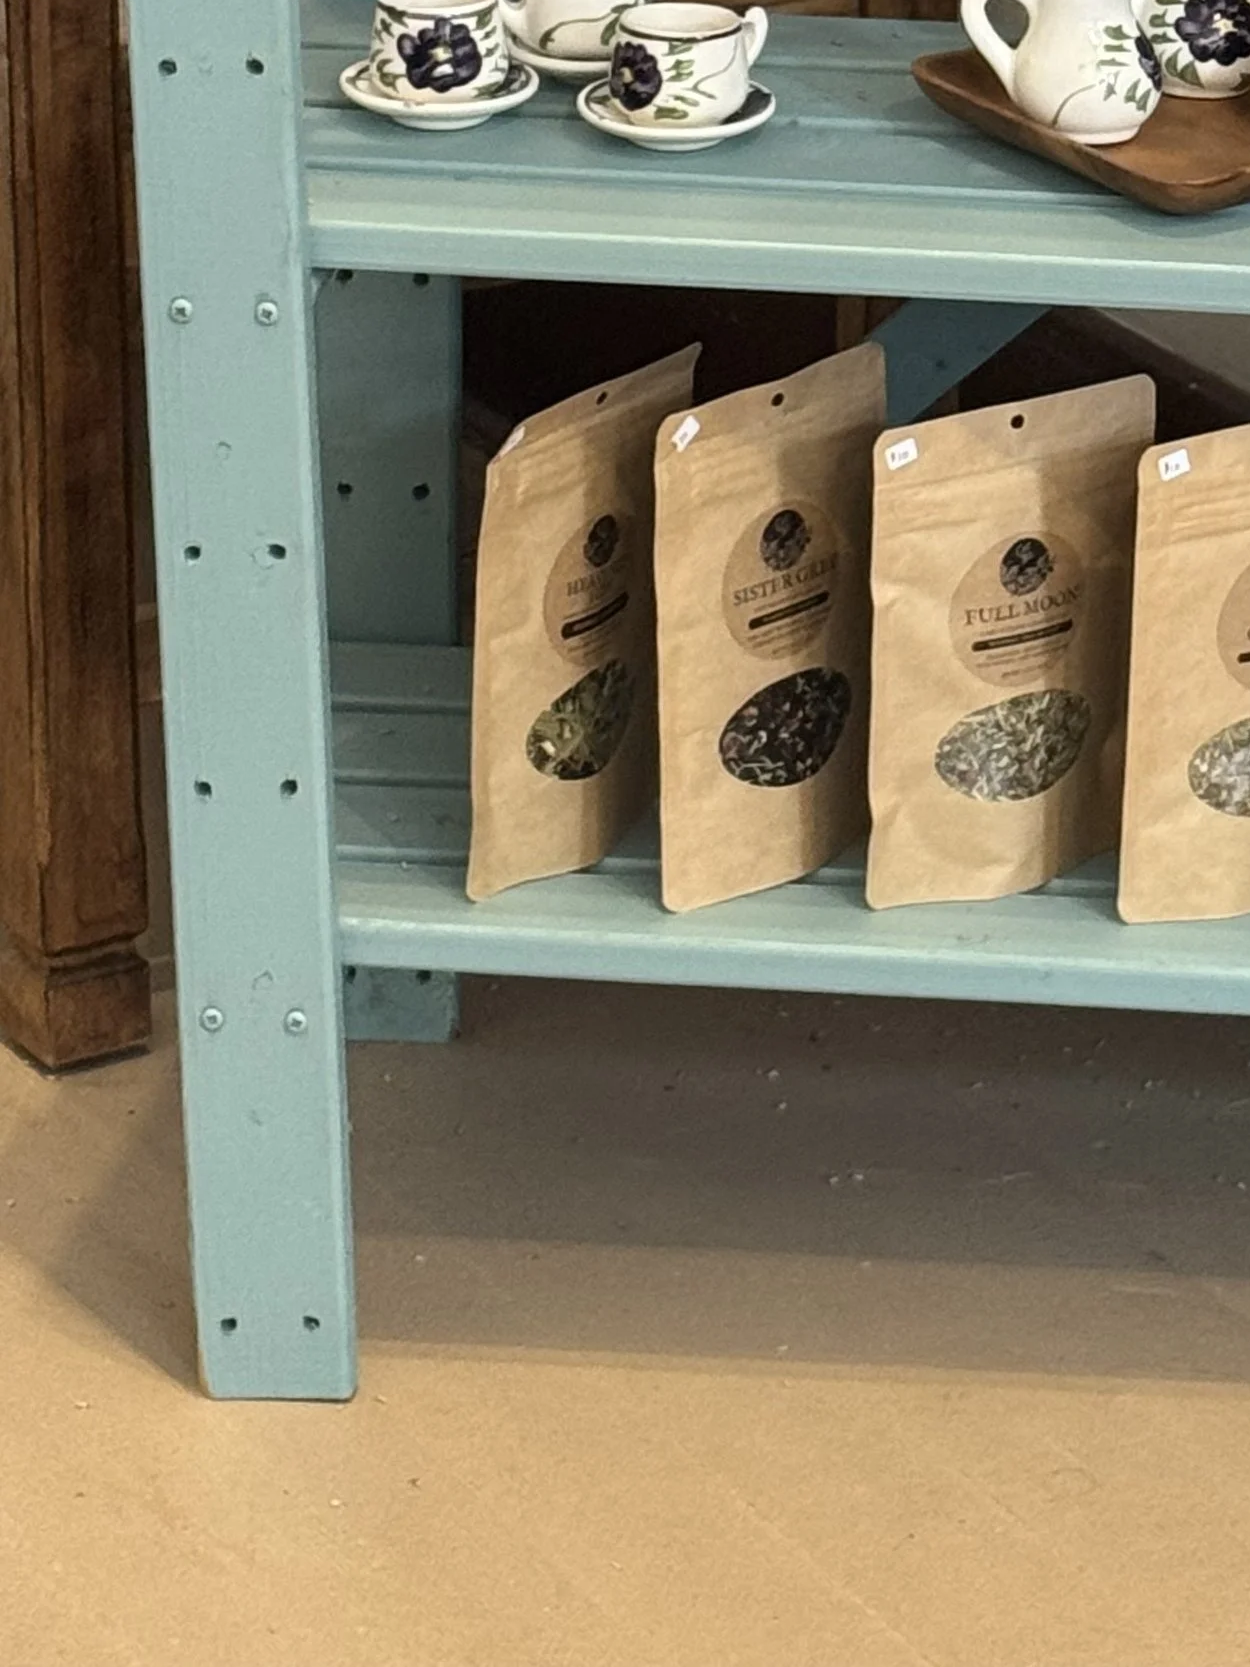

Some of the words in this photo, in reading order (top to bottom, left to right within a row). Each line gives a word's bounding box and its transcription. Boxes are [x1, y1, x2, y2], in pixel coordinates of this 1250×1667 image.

[732, 572, 794, 607] SISTER
[964, 603, 1021, 626] FULL
[1023, 585, 1080, 615] MOON
